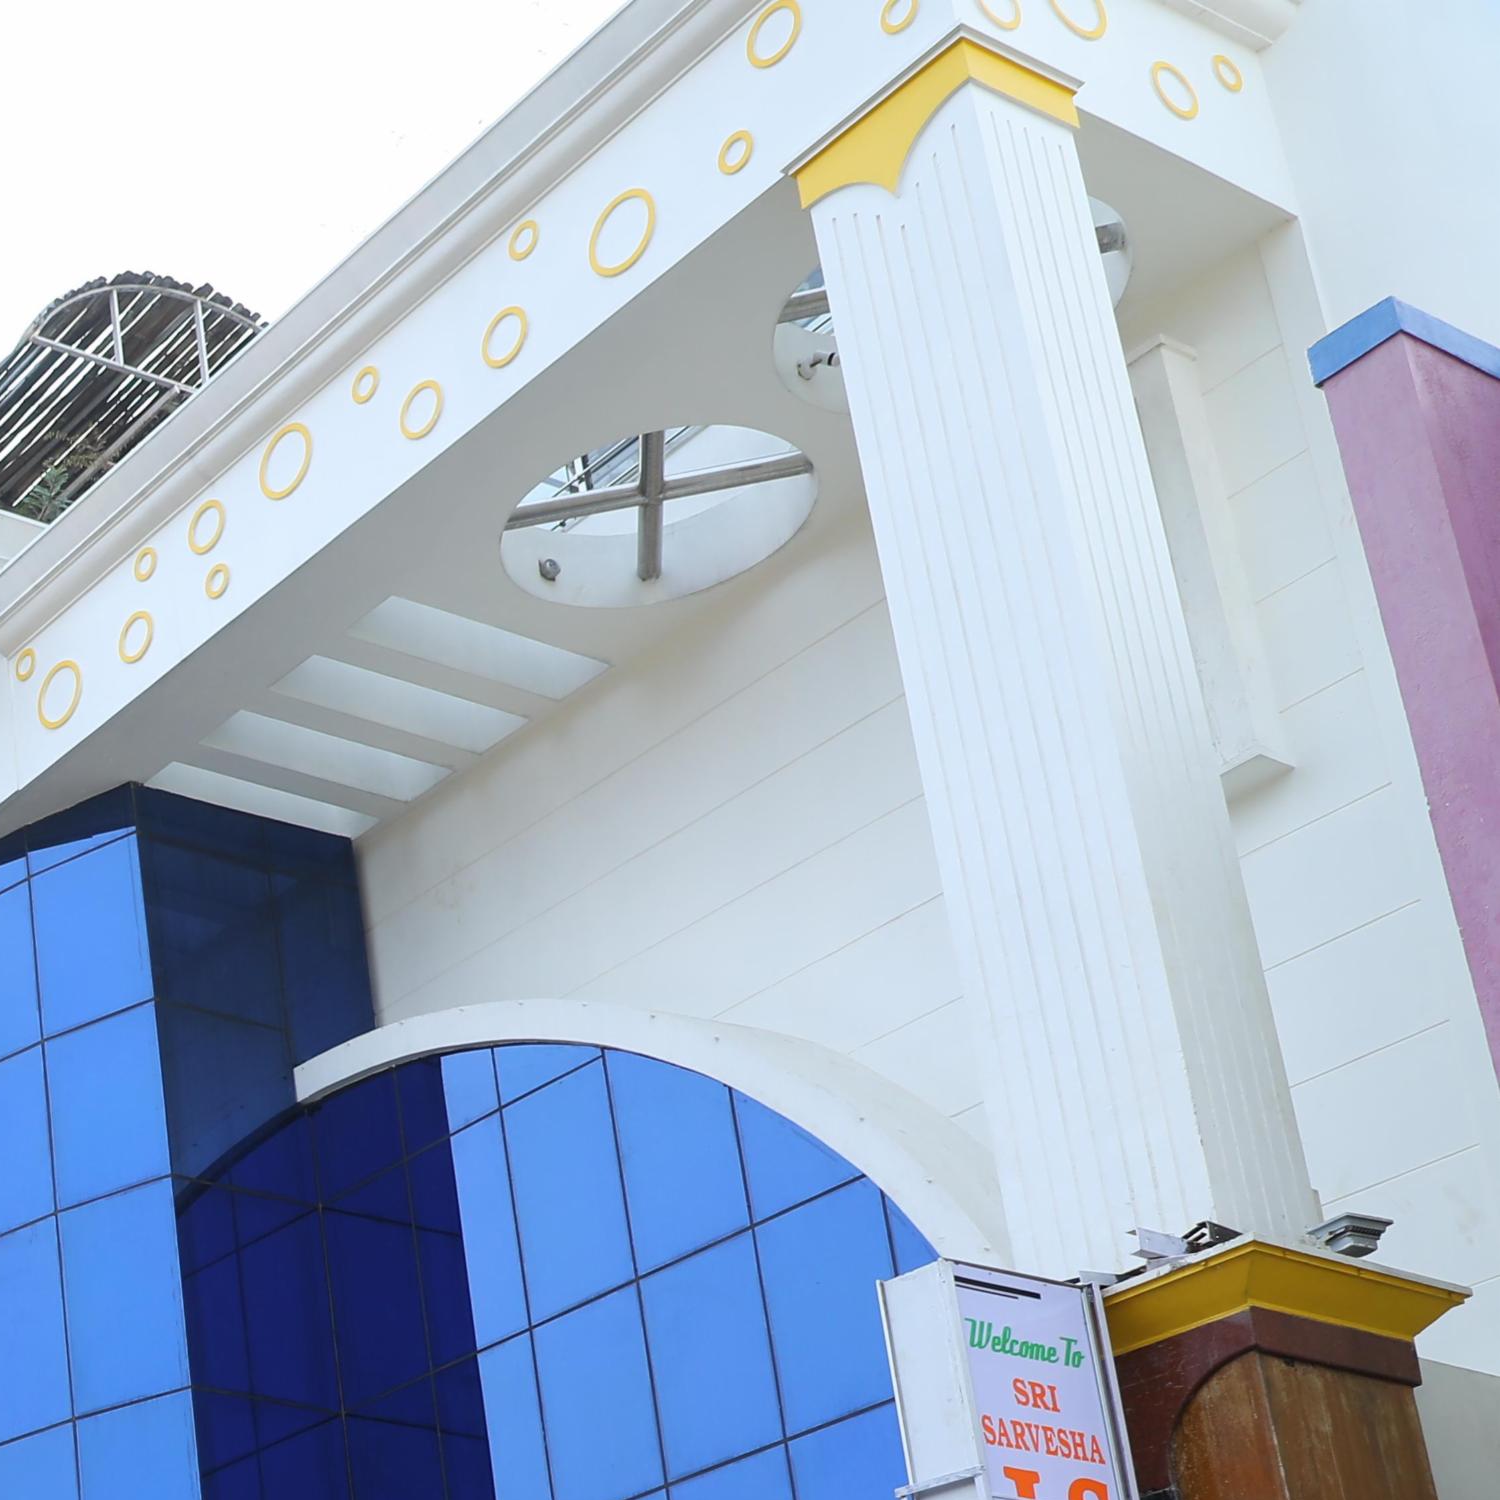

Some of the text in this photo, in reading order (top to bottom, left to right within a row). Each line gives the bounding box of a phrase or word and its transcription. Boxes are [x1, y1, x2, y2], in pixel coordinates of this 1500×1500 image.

[964, 1317, 1085, 1368] Welcome To
[1012, 1377, 1061, 1413] SRI
[981, 1414, 1106, 1465] SARVESHA
